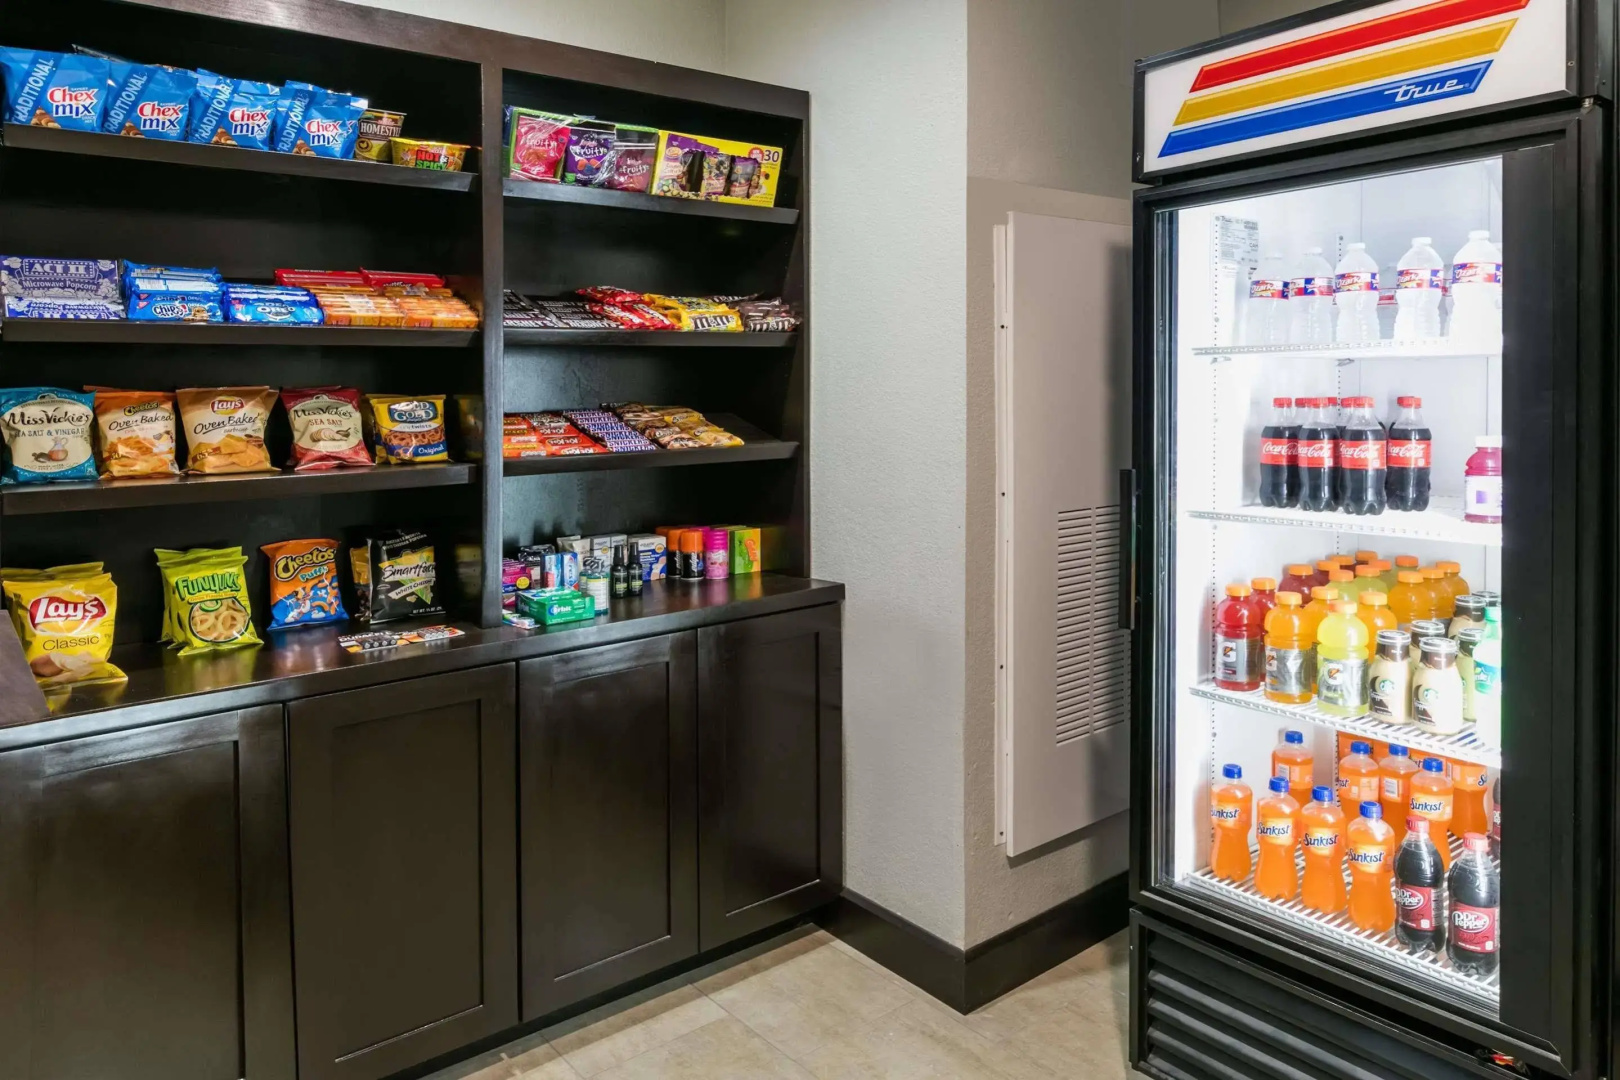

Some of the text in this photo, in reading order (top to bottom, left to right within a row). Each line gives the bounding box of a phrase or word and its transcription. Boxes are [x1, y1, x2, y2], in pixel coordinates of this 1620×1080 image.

[48, 87, 99, 104] Chex
[103, 73, 148, 133] RADITIONAL
[53, 101, 97, 118] mix
[138, 101, 185, 118] Chex
[229, 107, 271, 123] Chex
[141, 116, 181, 132] mix
[232, 121, 270, 136] mix
[280, 93, 311, 153] RADITIONAL
[306, 118, 343, 134] Chex
[310, 132, 342, 147] mix
[417, 150, 449, 163] HOT &
[764, 150, 780, 163] 30
[417, 160, 447, 171] SPICY
[31, 263, 87, 274] ACT II
[22, 280, 98, 291] Microwave Popcorn
[124, 402, 159, 416] Cheetos
[294, 409, 320, 421] Miss
[394, 409, 434, 421] GOLD
[8, 407, 90, 427] Miss Vickie's
[140, 412, 174, 424] Baked
[309, 418, 343, 426] SEA SALT
[27, 429, 45, 437] SALT
[46, 429, 53, 437] &
[194, 419, 227, 435] Oven
[418, 444, 445, 454] Original
[1297, 442, 1332, 459] oca-Cola
[1387, 443, 1427, 459] oca-Cola
[275, 547, 336, 580] Cheetos
[176, 572, 242, 601] FUNYUNS
[395, 586, 413, 596] WHITE
[35, 597, 99, 624] Lay's
[549, 604, 572, 616] Orbit
[42, 635, 100, 651] Classic
[1410, 798, 1443, 812] Sunkist
[1258, 822, 1291, 836] Sunkist
[1303, 832, 1338, 847] Sunkist
[1348, 848, 1384, 863] Sunkist
[1453, 911, 1487, 930] Pepper
[1464, 912, 1477, 921] Dr
